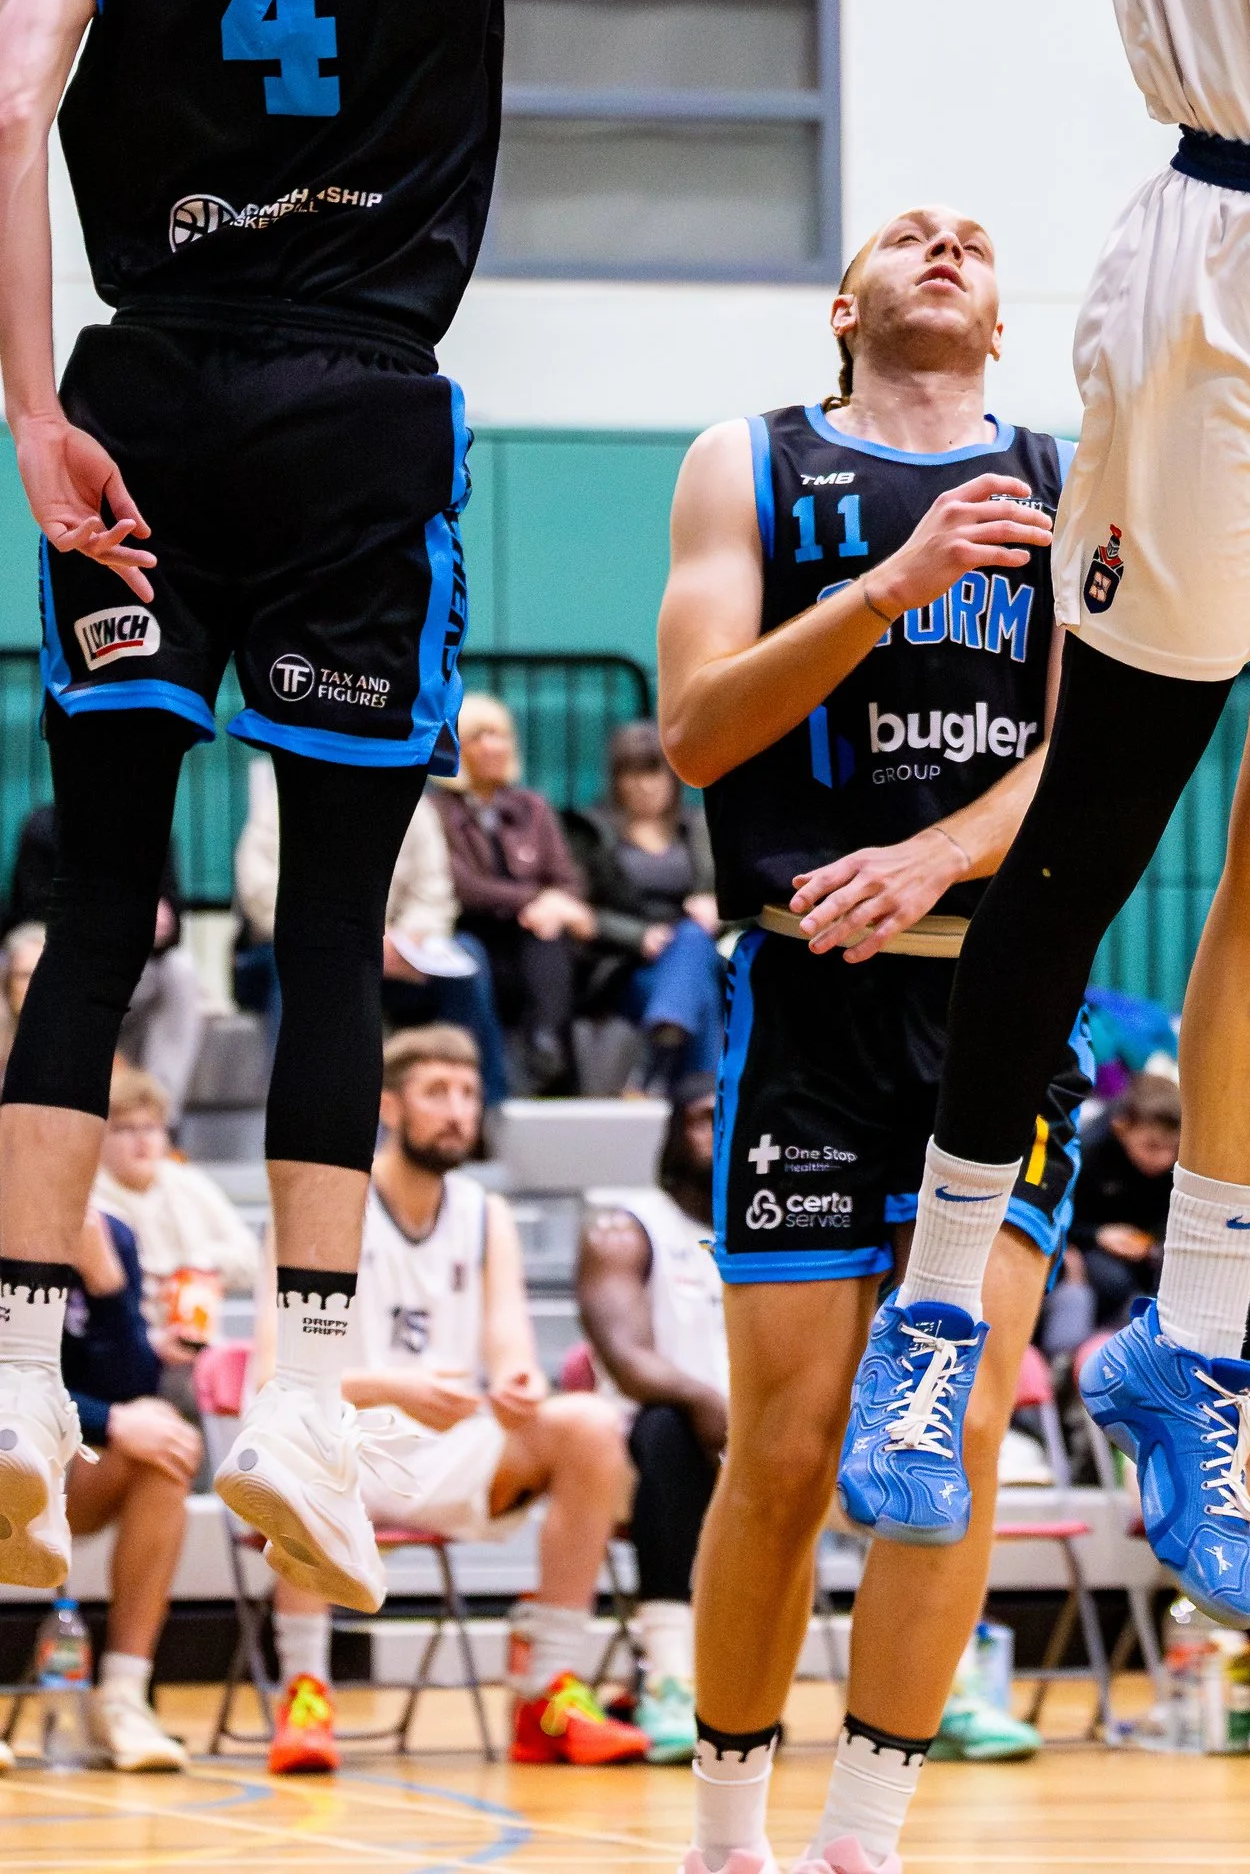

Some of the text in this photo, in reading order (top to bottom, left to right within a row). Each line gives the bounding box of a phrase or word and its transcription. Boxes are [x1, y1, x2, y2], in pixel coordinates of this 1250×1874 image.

[800, 472, 856, 486] TMB
[792, 494, 869, 563] 11
[82, 614, 150, 662] LYNCH
[320, 668, 391, 694] TAX AND
[318, 684, 388, 709] FIGURES
[868, 701, 1038, 764] bugler
[872, 763, 942, 786] GROUP
[784, 1145, 859, 1164] One Stop
[786, 1192, 854, 1214] certa
[302, 1317, 349, 1328] DRIPPY
[302, 1326, 348, 1337] GRIPPY
